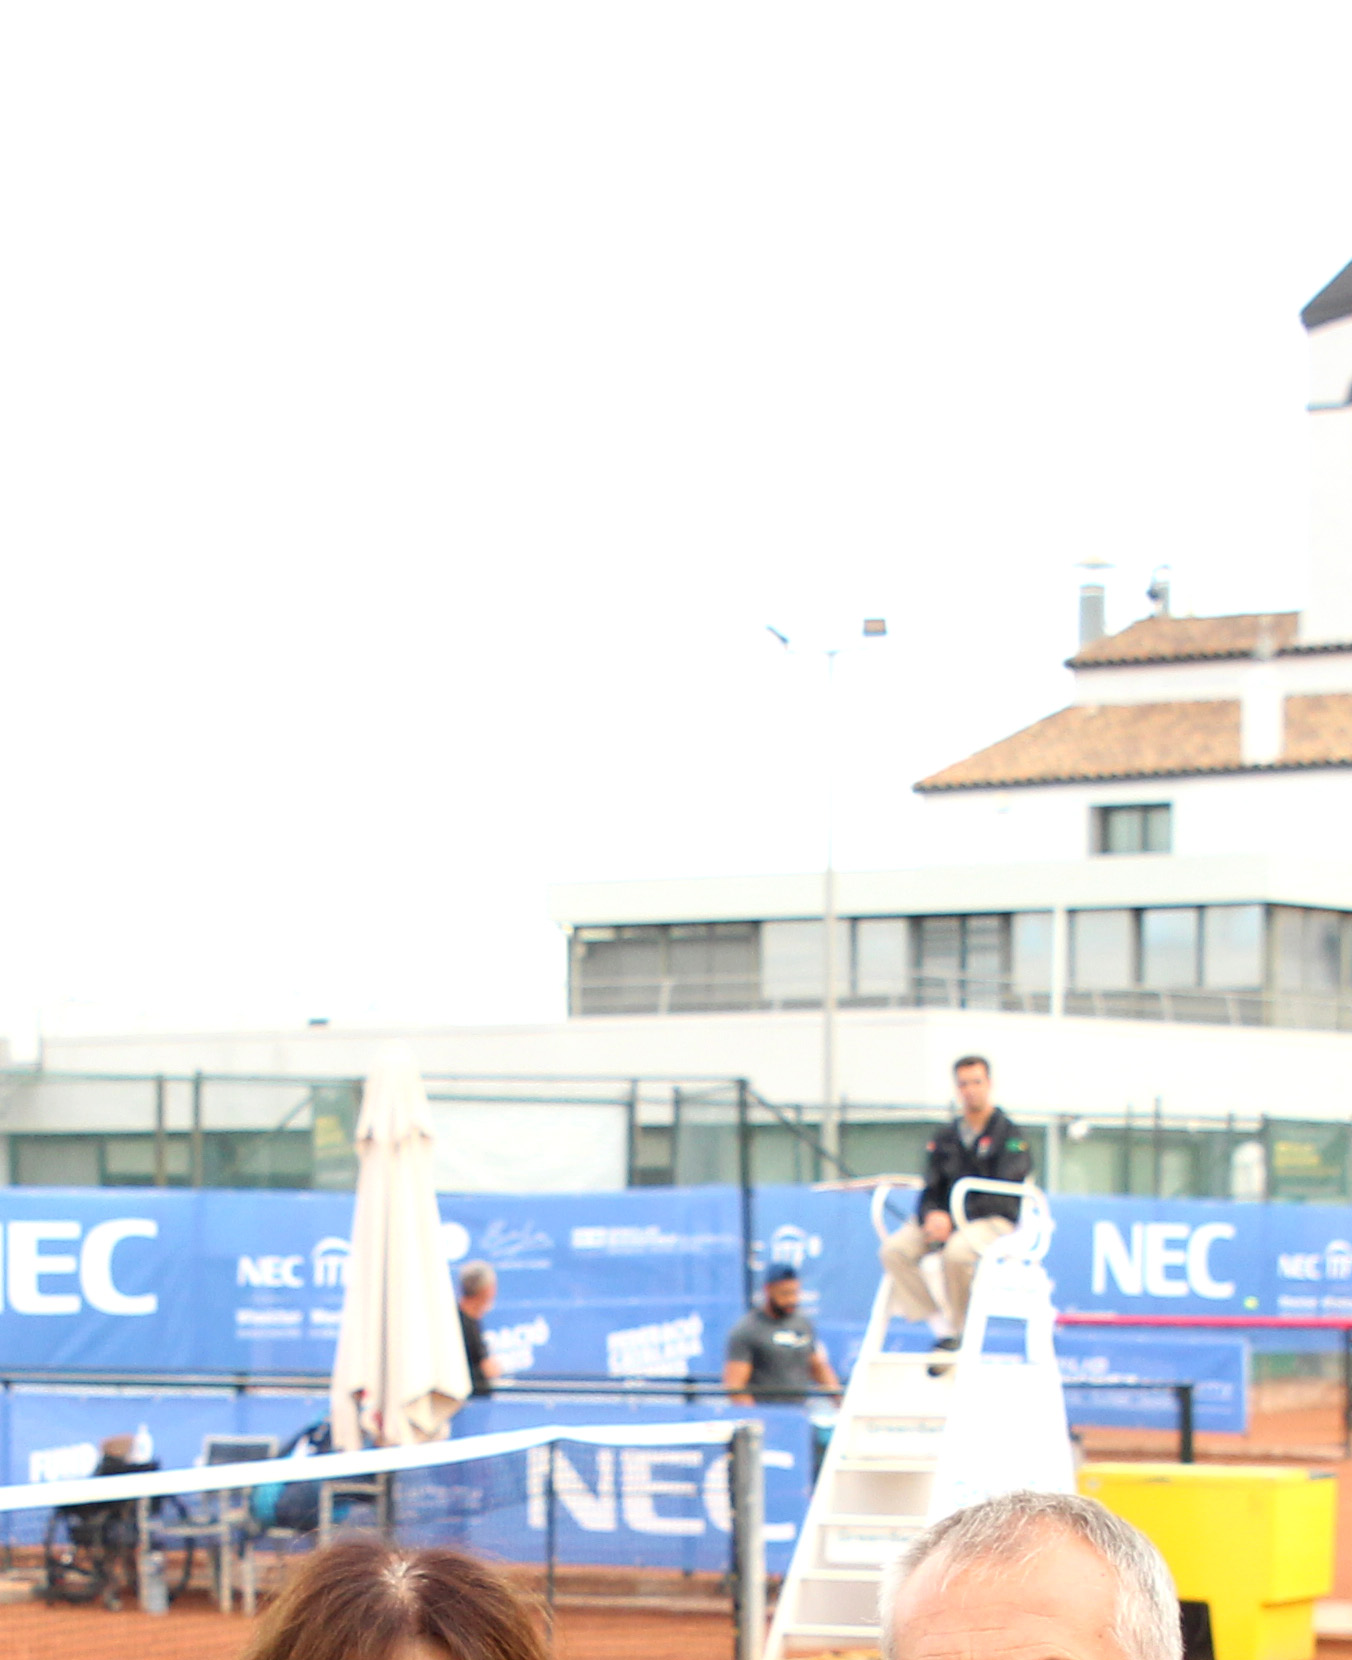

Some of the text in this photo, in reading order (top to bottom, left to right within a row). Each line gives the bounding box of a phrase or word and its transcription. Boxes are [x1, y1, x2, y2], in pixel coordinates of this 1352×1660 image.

[236, 1254, 305, 1288] NEC
[1091, 1219, 1237, 1300] NEC
[1277, 1252, 1322, 1280] NEC
[526, 1446, 796, 1541] NEC
